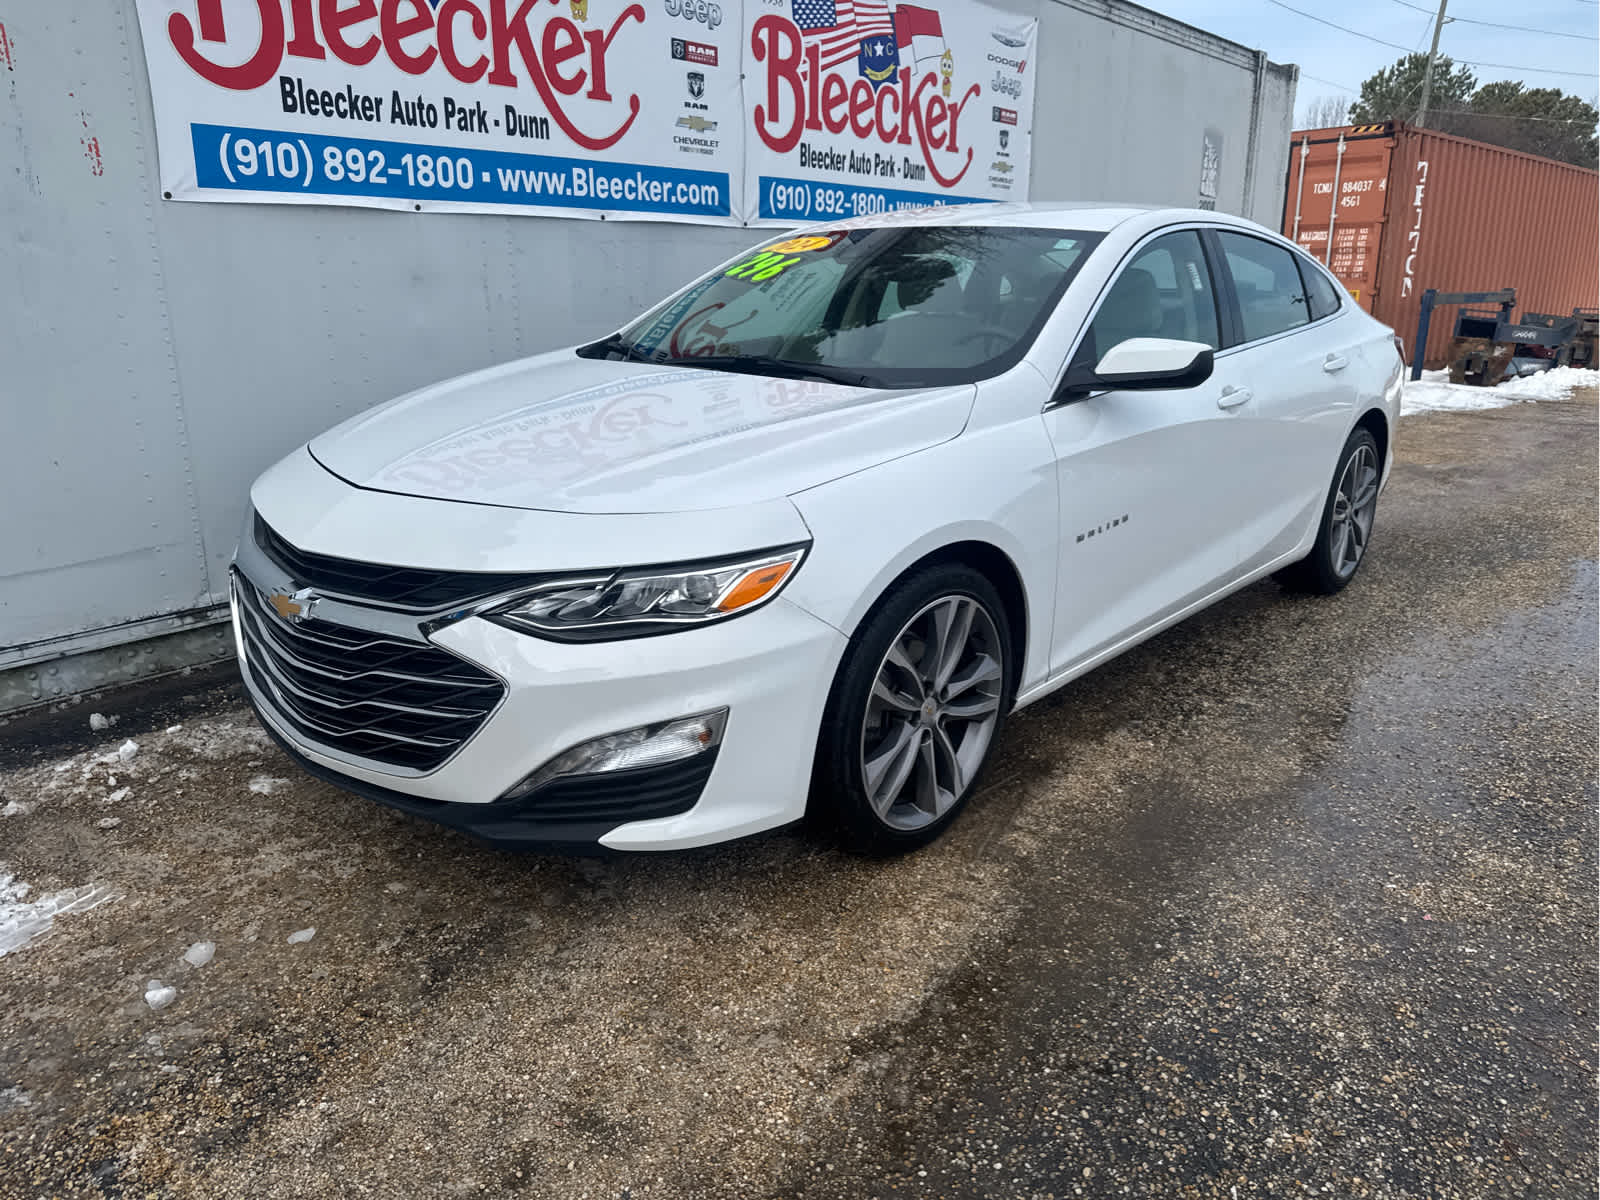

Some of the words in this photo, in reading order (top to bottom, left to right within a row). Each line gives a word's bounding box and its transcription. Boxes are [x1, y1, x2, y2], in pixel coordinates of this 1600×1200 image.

[664, 0, 722, 30] Jeep
[688, 45, 716, 57] RAM
[864, 43, 873, 57] N
[886, 42, 894, 56] C
[991, 70, 1022, 100] Jeep
[279, 75, 383, 122] Bleecker
[391, 90, 438, 129] Auto
[443, 96, 489, 134] Park
[505, 104, 550, 140] Dunn
[684, 101, 708, 111] RAM
[752, 14, 981, 188] Bleecker
[673, 136, 719, 148] CHEVROLET
[219, 132, 313, 187] (910)
[323, 146, 474, 190] 892-1800
[497, 167, 719, 206] www.Bleecker.com
[800, 142, 847, 173] Bleecker
[849, 149, 872, 176] Auto
[874, 153, 896, 178] Park
[903, 156, 926, 181] Dunn
[769, 181, 811, 216] (910)
[815, 187, 886, 216] 892-1800
[1313, 183, 1333, 194] TCNU
[1342, 180, 1374, 193] 884037
[1340, 195, 1360, 207] 45G1
